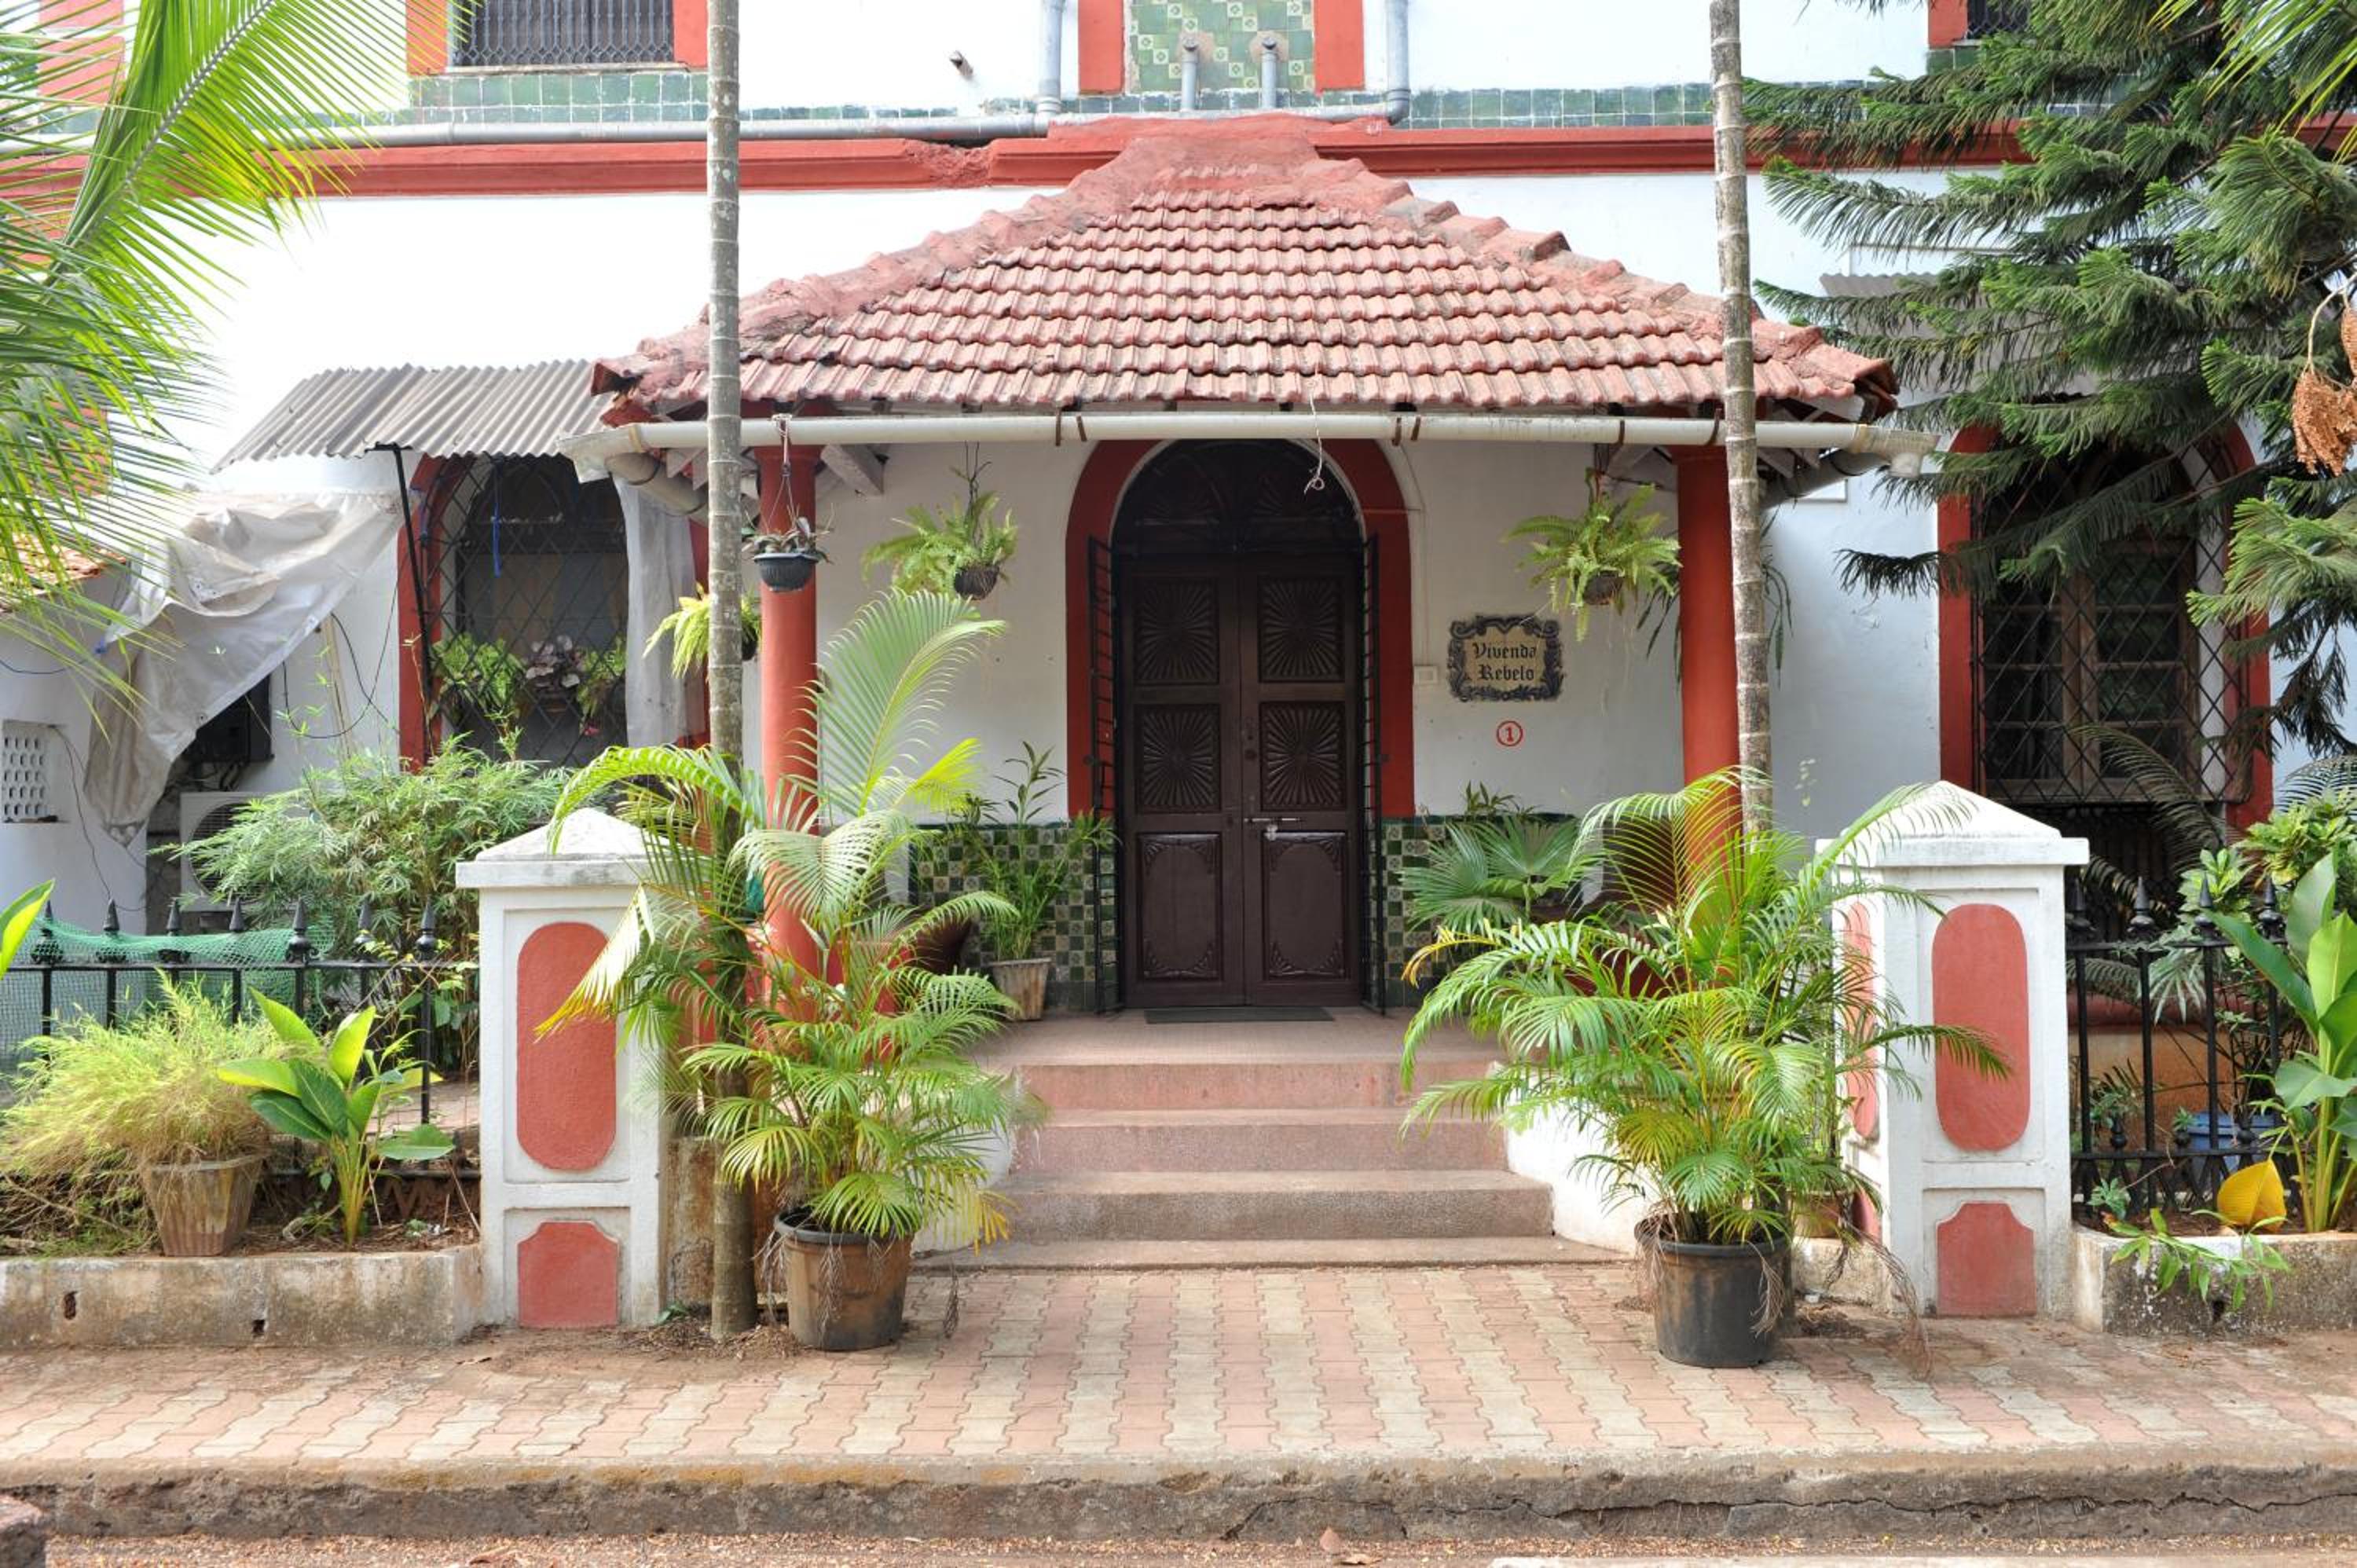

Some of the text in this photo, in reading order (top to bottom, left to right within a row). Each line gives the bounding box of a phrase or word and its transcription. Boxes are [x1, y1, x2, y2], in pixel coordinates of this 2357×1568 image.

[1472, 643, 1537, 658] Vivenda
[1479, 664, 1534, 681] Rebelo
[1505, 727, 1514, 742] 1
